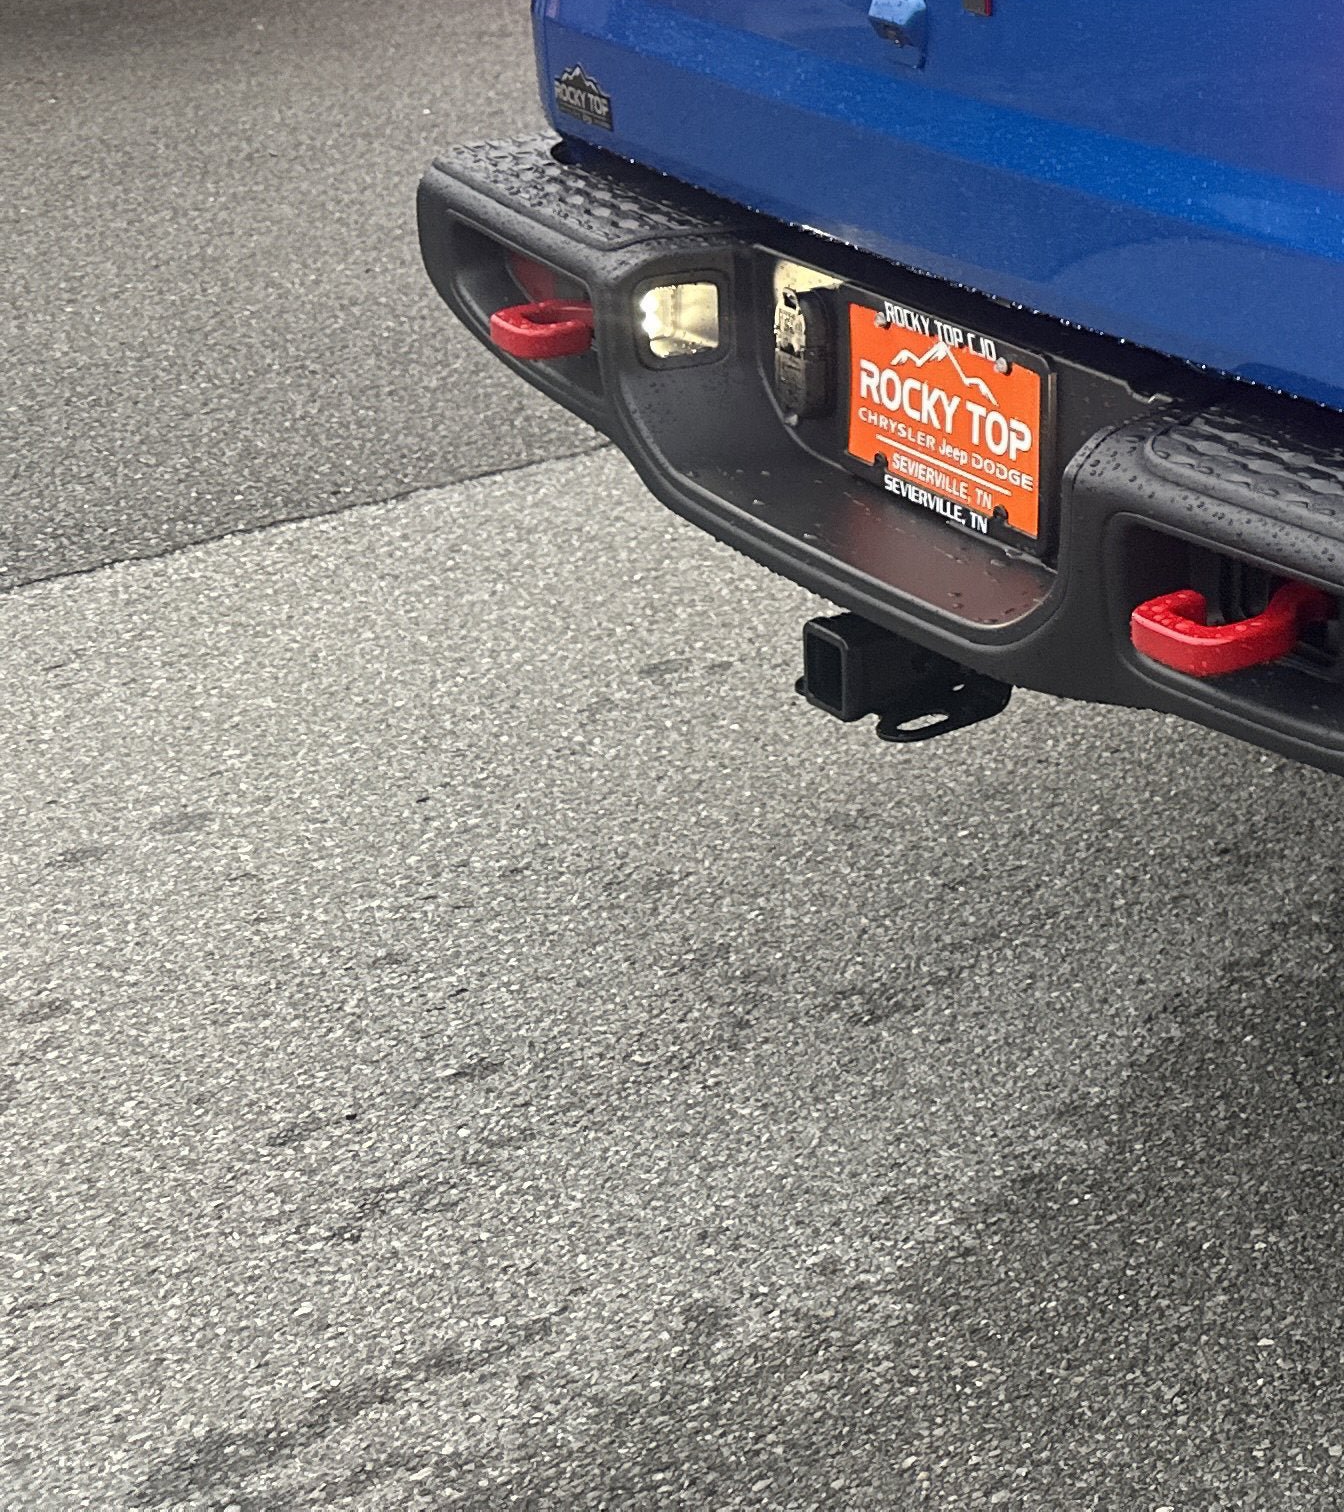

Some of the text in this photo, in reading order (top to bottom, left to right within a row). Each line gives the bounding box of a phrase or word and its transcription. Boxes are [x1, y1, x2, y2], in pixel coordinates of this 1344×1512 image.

[884, 300, 997, 362] ROCKY TOP CJD
[859, 359, 1032, 461] ROCKY TOP
[857, 406, 1034, 491] CHRYSLER Jeep DODGE
[884, 473, 988, 534] SEVIERVILLE, TN
[892, 451, 993, 510] SEVIERVILLE, TN
